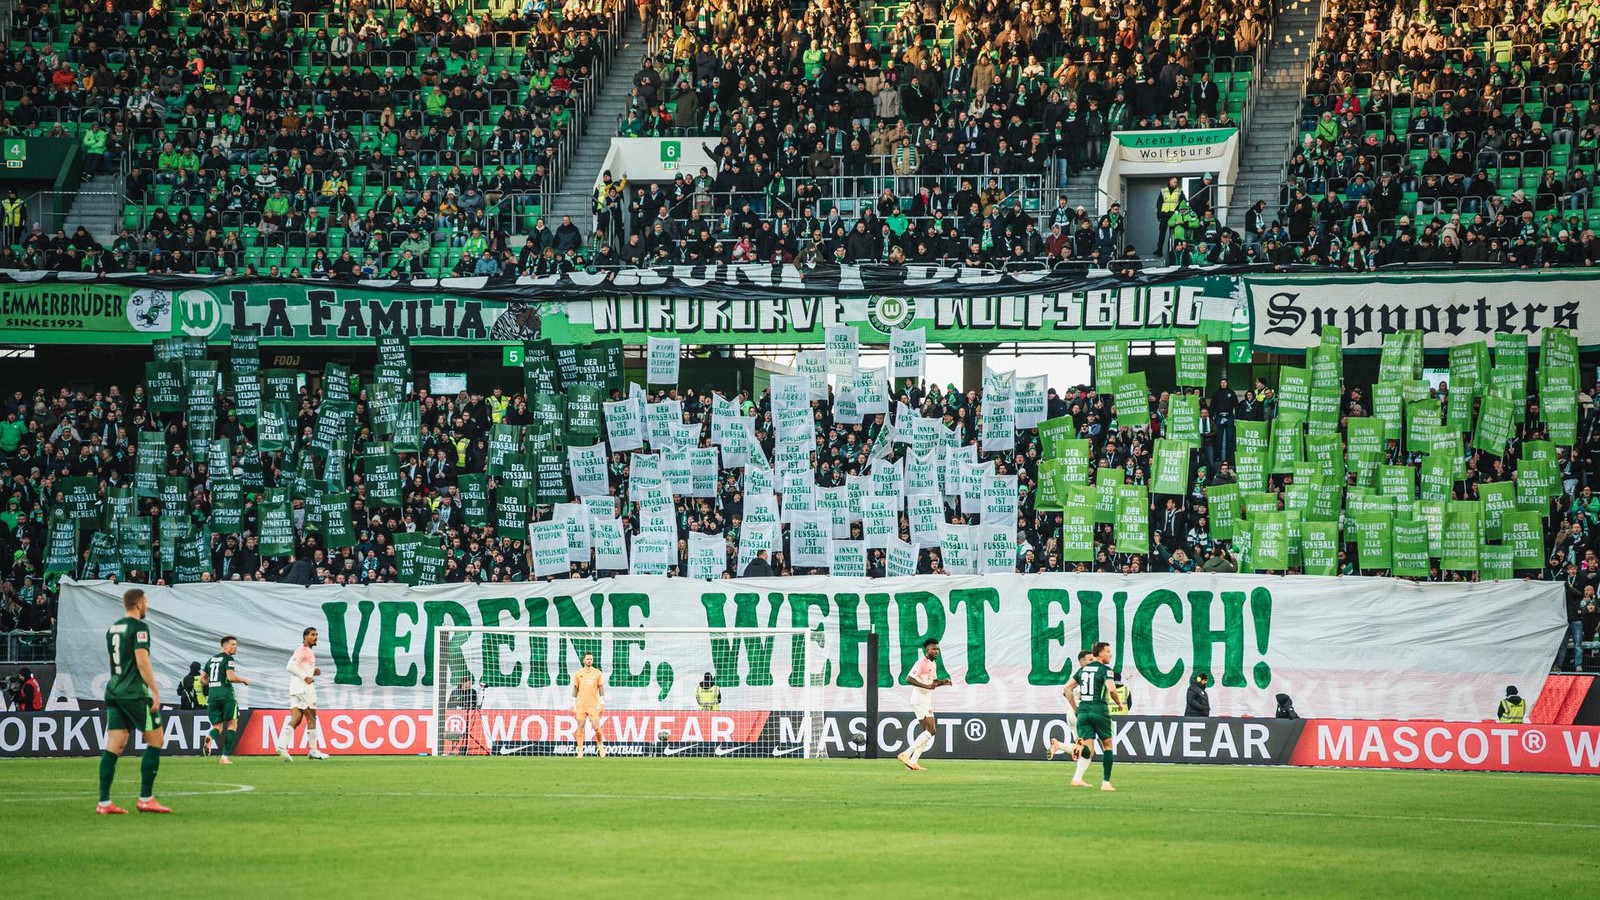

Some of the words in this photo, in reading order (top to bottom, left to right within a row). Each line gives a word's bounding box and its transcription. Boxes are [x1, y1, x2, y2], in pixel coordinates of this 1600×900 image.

[1135, 134, 1173, 146] Arena
[1181, 131, 1218, 143] Power
[11, 144, 20, 156] 4
[666, 145, 675, 158] 6
[1140, 146, 1211, 158] Wolfsburg
[0, 286, 123, 318] EMMERBRÜDER
[230, 290, 295, 337] LA
[307, 290, 487, 339] FAMILIA
[1263, 292, 1581, 345] Supporters
[6, 318, 84, 328] SINCE1992
[510, 350, 518, 364] 5
[1237, 346, 1246, 359] 7
[573, 458, 604, 467] FUSSBALL
[1067, 465, 1077, 473] IST
[993, 480, 1006, 488] DER
[863, 510, 894, 518] FUSSBALL
[498, 520, 524, 528] SICHER!
[867, 526, 893, 535] SICHER!
[1504, 532, 1539, 540] FUSSBALL
[321, 592, 675, 702] VEREINE,
[701, 587, 1001, 688] WEHRT
[1027, 586, 1273, 689] EUCH!
[209, 663, 219, 682] 11
[1081, 671, 1095, 695] 31
[1001, 718, 1271, 759] WOKWEAR
